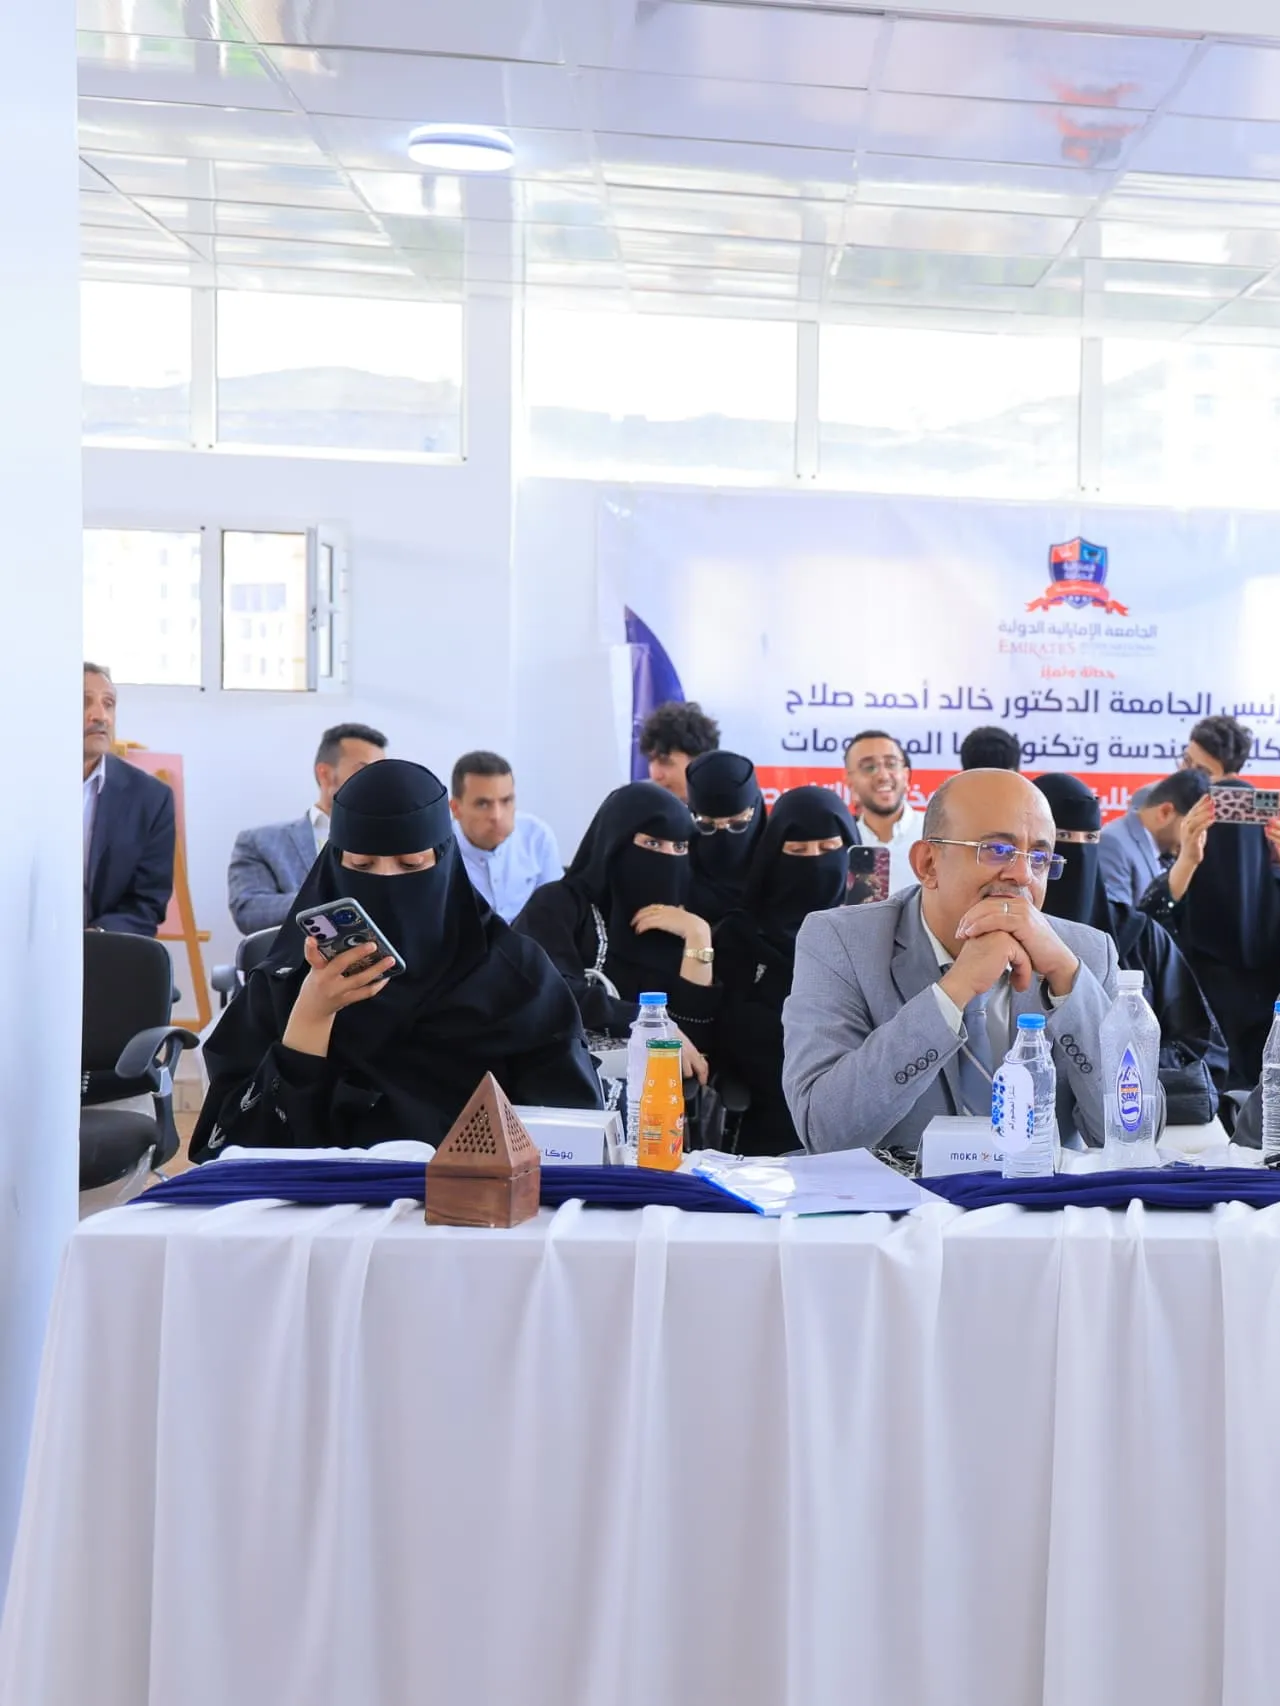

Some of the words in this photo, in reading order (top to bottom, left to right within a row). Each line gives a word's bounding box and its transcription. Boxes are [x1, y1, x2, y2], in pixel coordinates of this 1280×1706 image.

[785, 682, 854, 714] صلاح
[864, 680, 928, 709] أحمد
[939, 682, 993, 710] خالد
[1001, 688, 1099, 718] الدكتور
[1110, 691, 1212, 722] الجامعة
[1108, 735, 1186, 759] ندسة
[545, 1148, 574, 1160] موكا
